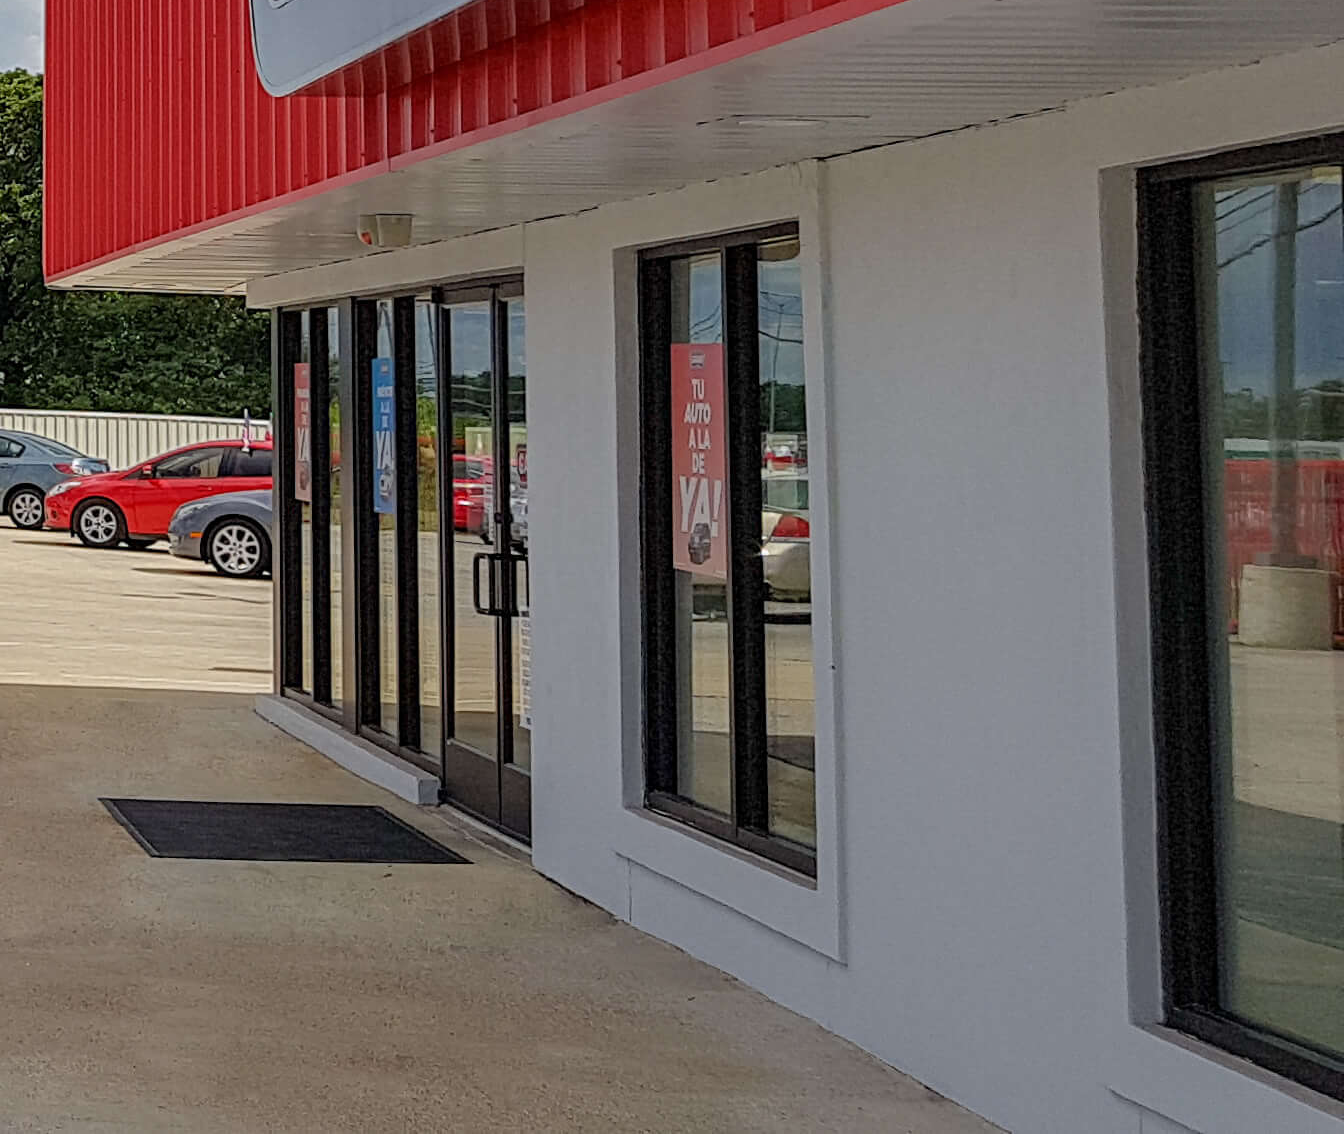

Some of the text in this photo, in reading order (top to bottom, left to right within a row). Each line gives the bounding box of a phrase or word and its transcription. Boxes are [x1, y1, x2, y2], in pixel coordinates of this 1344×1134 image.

[691, 378, 705, 400] TU
[684, 403, 712, 424] AUTO
[692, 452, 705, 474] DE
[679, 475, 722, 538] YA!
